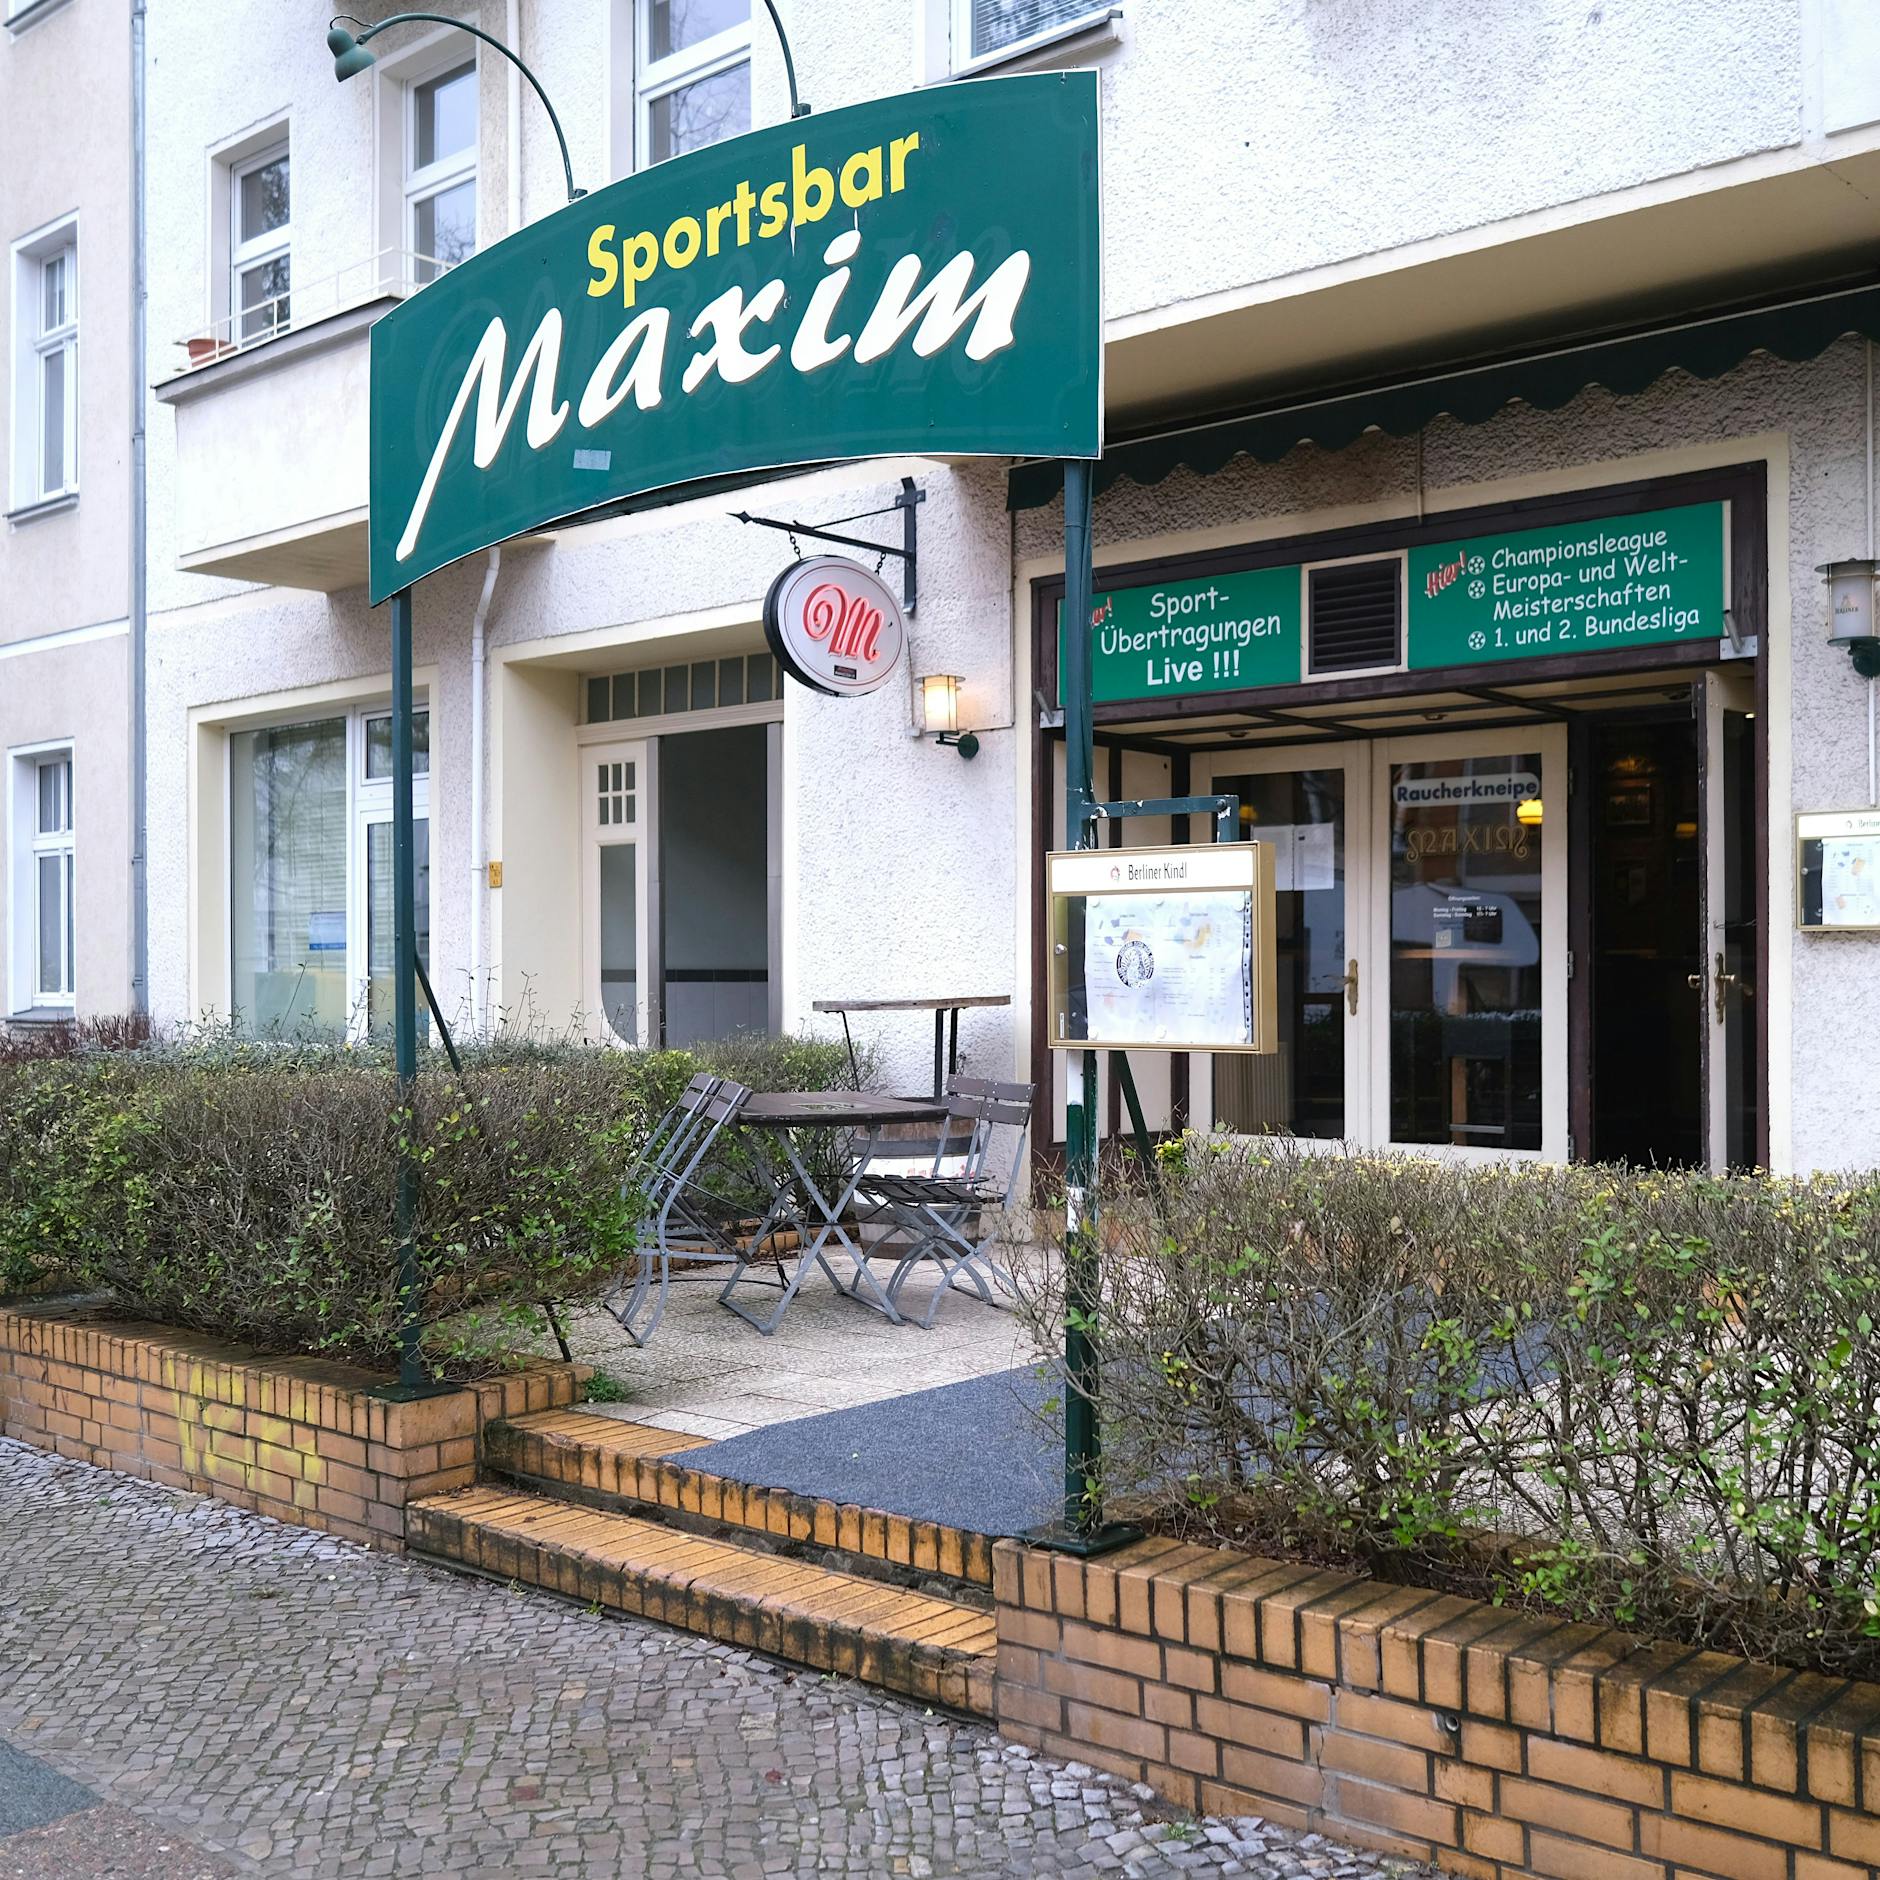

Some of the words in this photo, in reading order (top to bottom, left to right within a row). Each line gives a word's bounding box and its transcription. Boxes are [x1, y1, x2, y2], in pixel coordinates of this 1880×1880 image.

[587, 132, 920, 307] Sportsbar
[395, 229, 1031, 562] Maxim
[1491, 530, 1668, 570] Championsleague
[1424, 550, 1467, 600] Hier!
[1492, 572, 1571, 597] Europa-
[1578, 559, 1616, 584] und
[1624, 552, 1689, 577] Welt-
[1150, 586, 1230, 623] Sport-
[1493, 583, 1671, 621] Meisterschaften
[1100, 615, 1281, 655] Übertragungen
[1494, 628, 1509, 648] 1.
[1515, 622, 1551, 646] und
[1558, 619, 1577, 640] 2.
[1585, 607, 1700, 638] Bundesliga
[1146, 657, 1203, 686] Live
[1213, 649, 1241, 679] !!!
[1397, 778, 1537, 802] Raucherkneipe
[1406, 824, 1529, 864] MAXIM
[1128, 864, 1161, 881] Berliner
[1163, 861, 1187, 880] Kindl
